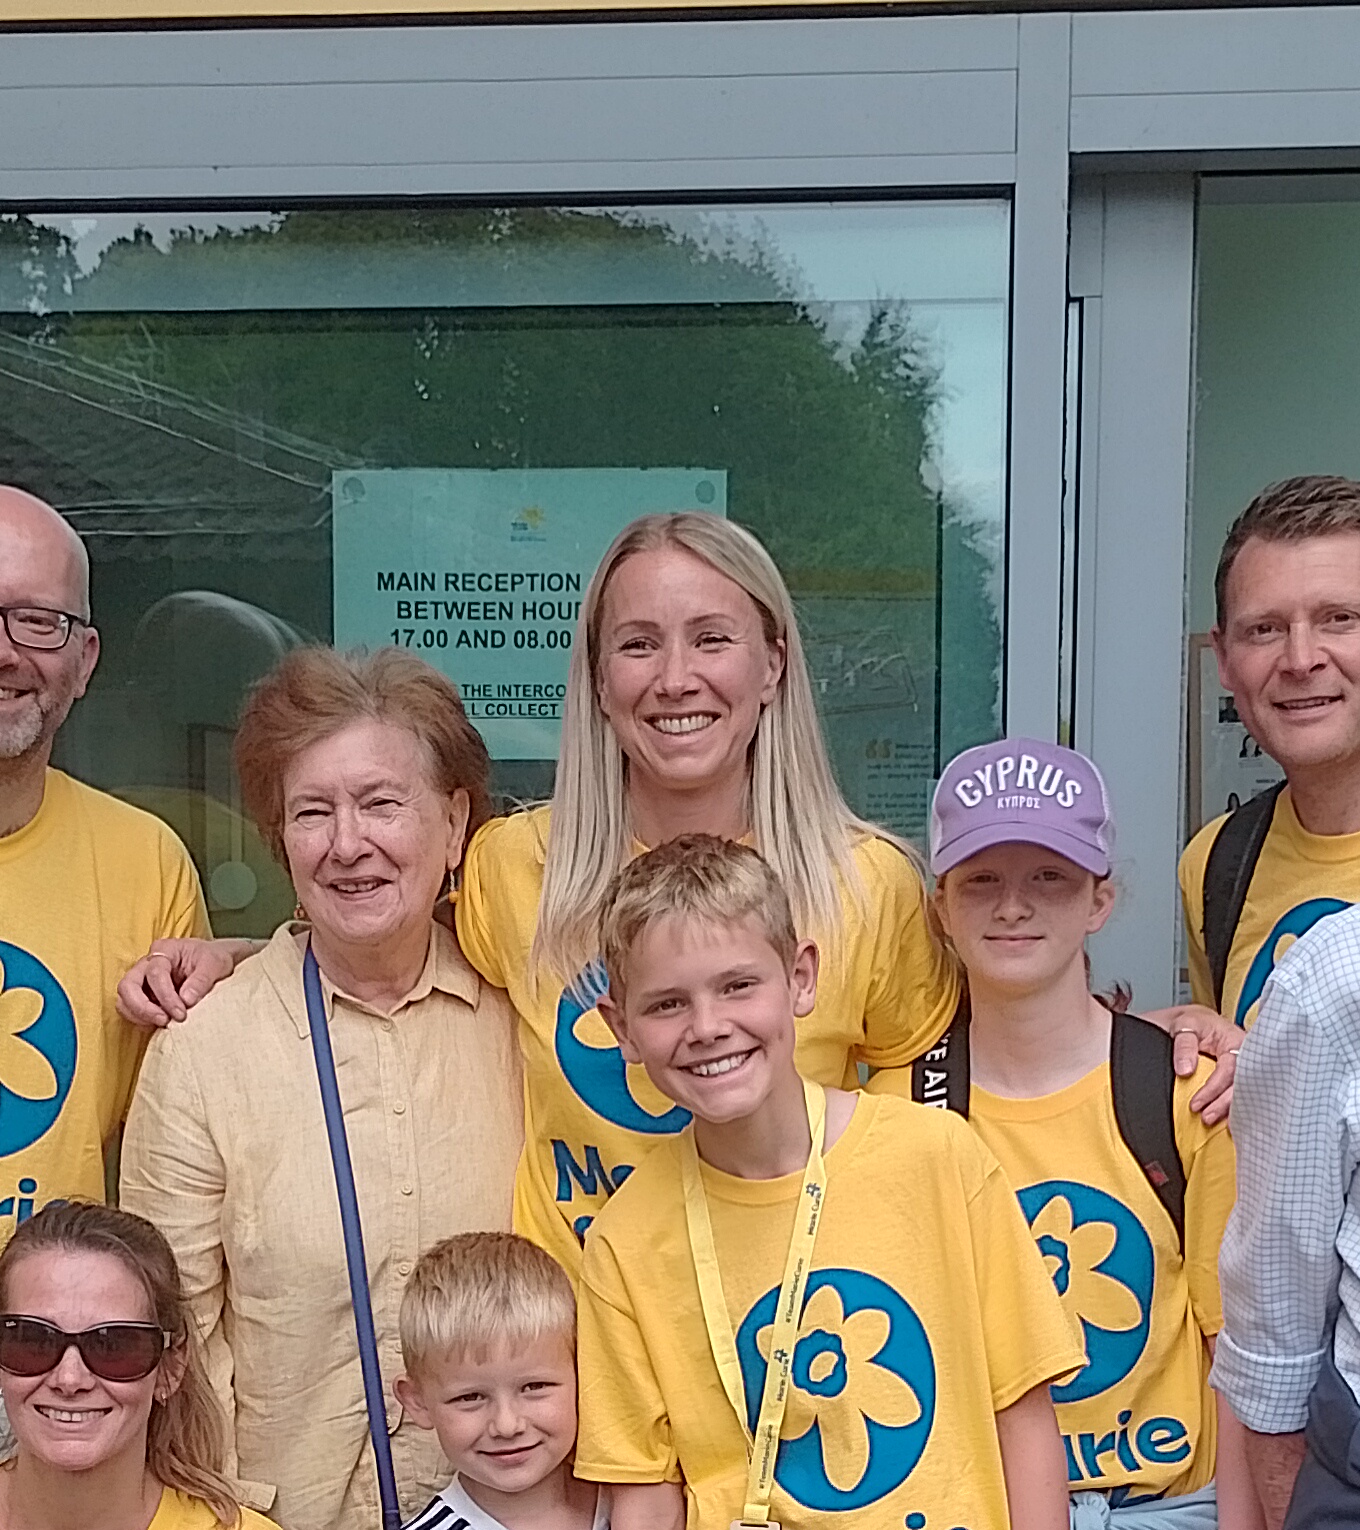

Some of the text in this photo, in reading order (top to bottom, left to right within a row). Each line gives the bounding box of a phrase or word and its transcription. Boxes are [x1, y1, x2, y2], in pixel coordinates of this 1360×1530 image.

[377, 572, 581, 592] MAIN RECEPTION
[397, 601, 513, 620] BETWEEN
[391, 629, 572, 649] 17.00 AND 08.00
[461, 684, 493, 698] THE
[485, 703, 559, 717] COLLECT
[954, 754, 1082, 808] CYPRUS
